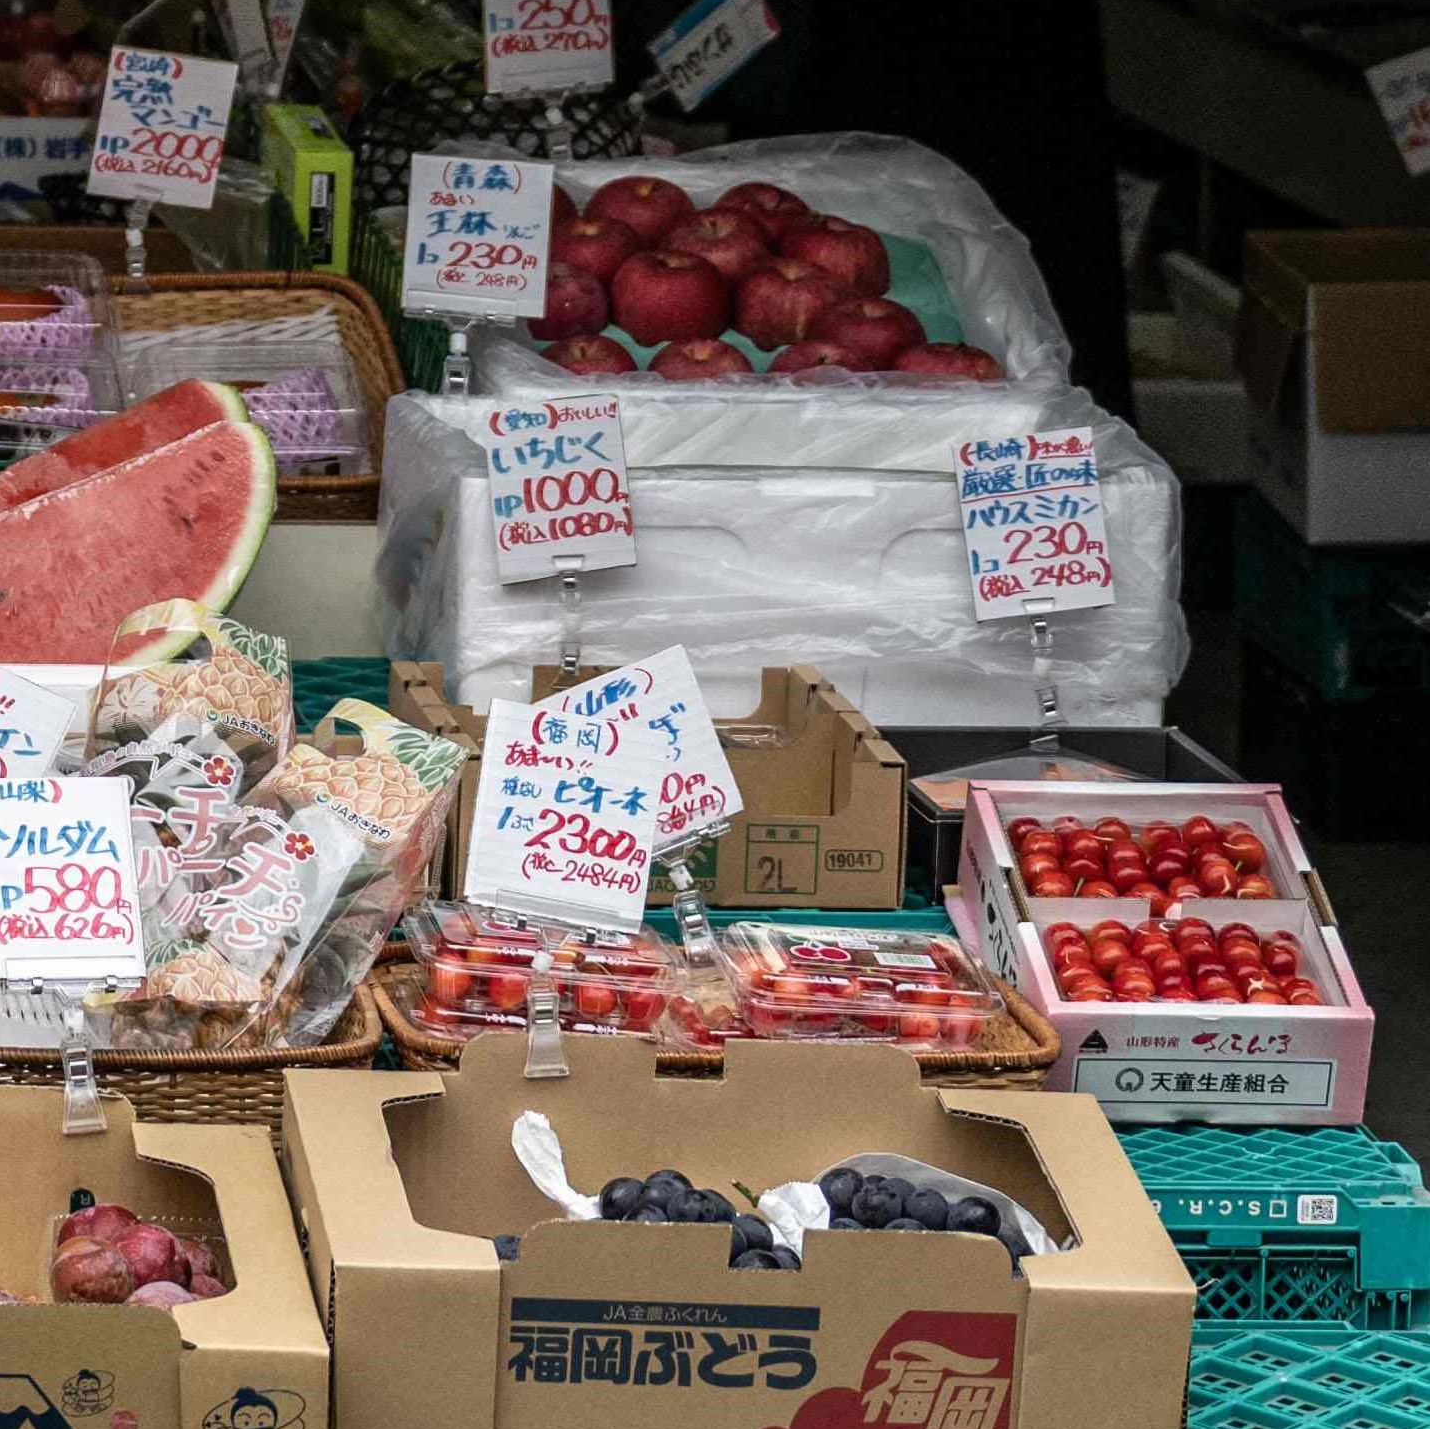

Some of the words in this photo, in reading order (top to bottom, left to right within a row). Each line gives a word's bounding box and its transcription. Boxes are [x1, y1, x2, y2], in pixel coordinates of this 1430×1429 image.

[111, 74, 174, 105] 完熟
[130, 105, 226, 131] マンゴー
[442, 161, 522, 195] (青森)
[491, 431, 613, 474] いちじく
[967, 494, 1099, 529] ハウスミカン
[1003, 521, 1104, 565] 230円
[531, 711, 619, 757] (福岡)
[553, 776, 650, 816] ピオーネ
[757, 856, 798, 893] 2L
[1126, 1035, 1180, 1050] 山形特産
[1149, 1071, 1291, 1095] 天童生産組合
[602, 1303, 729, 1325] JA全農ふくれん
[510, 1325, 818, 1390] 福岡ぶどう
